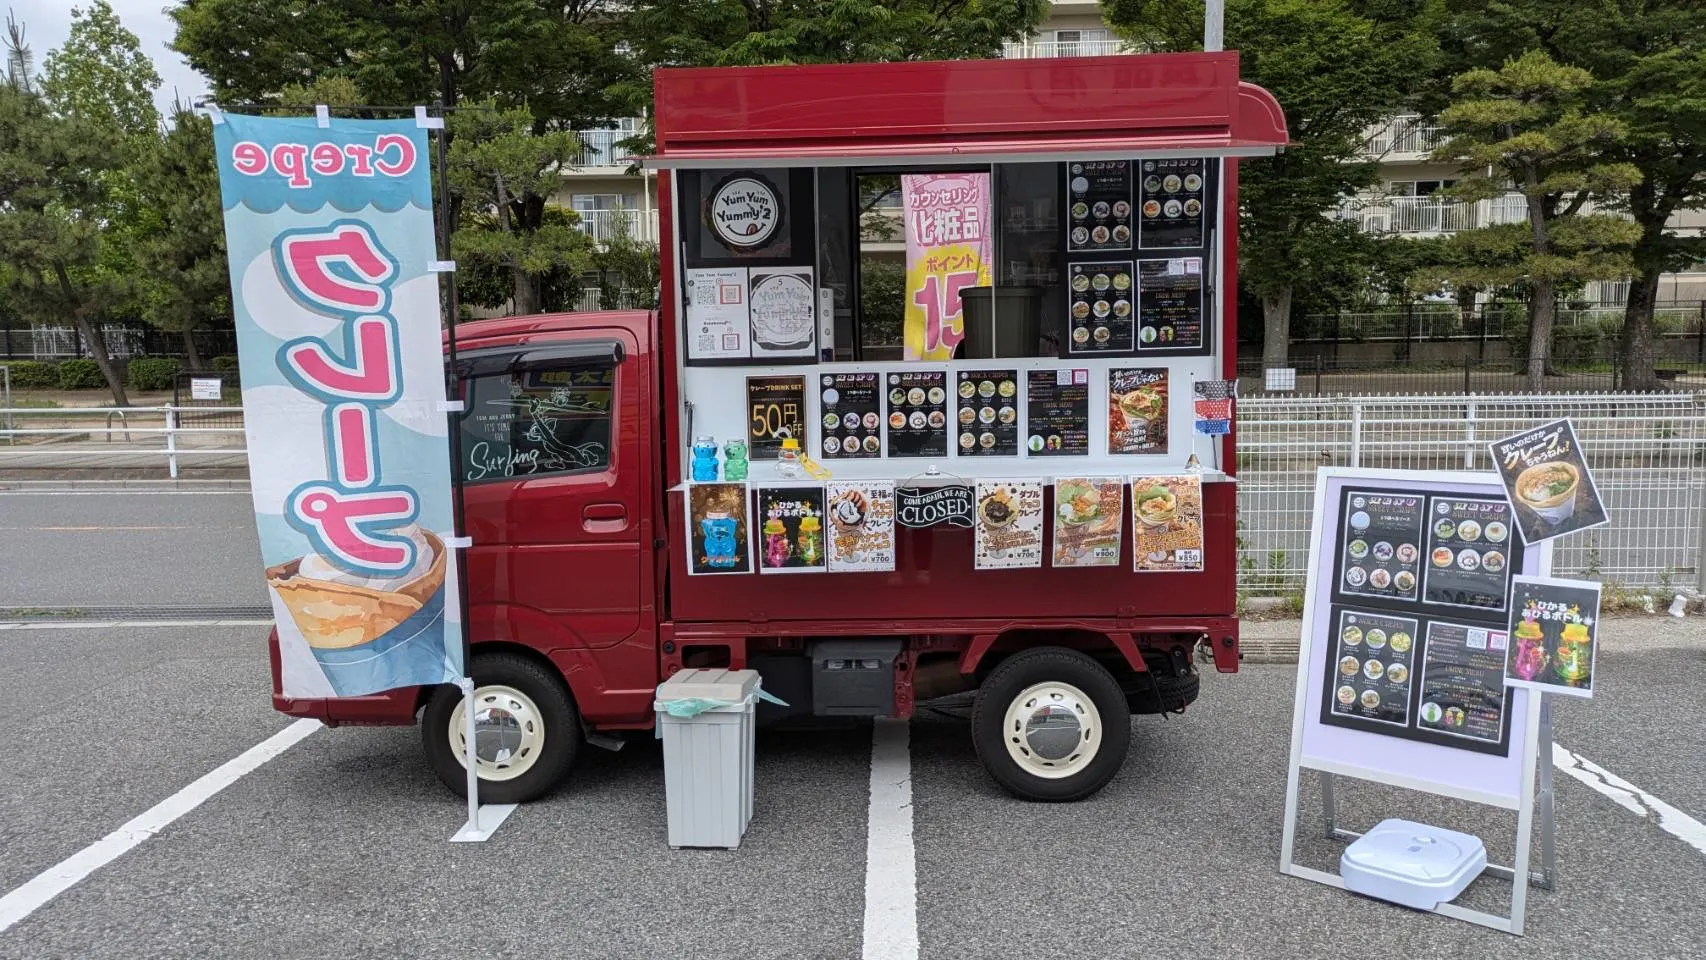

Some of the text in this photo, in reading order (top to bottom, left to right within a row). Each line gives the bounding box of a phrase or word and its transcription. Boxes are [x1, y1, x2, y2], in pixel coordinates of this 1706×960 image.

[722, 191, 768, 206] Yum Yum
[910, 187, 978, 208] カウンセリング
[911, 206, 982, 246] 化粧品
[926, 254, 974, 272] ポイント
[1504, 427, 1563, 470] クレープ
[467, 442, 540, 481] Surfing
[870, 489, 893, 499] 至福の
[903, 497, 922, 505] COME
[944, 489, 954, 497] WE
[954, 489, 968, 499] ARE
[1019, 490, 1041, 498] ダブル
[779, 501, 802, 509] ひかる
[871, 499, 893, 509] チョコ
[902, 498, 968, 523] CLOSED
[1018, 508, 1041, 517] クレープ
[870, 519, 893, 527] クレープ
[1537, 601, 1567, 612] ひかる
